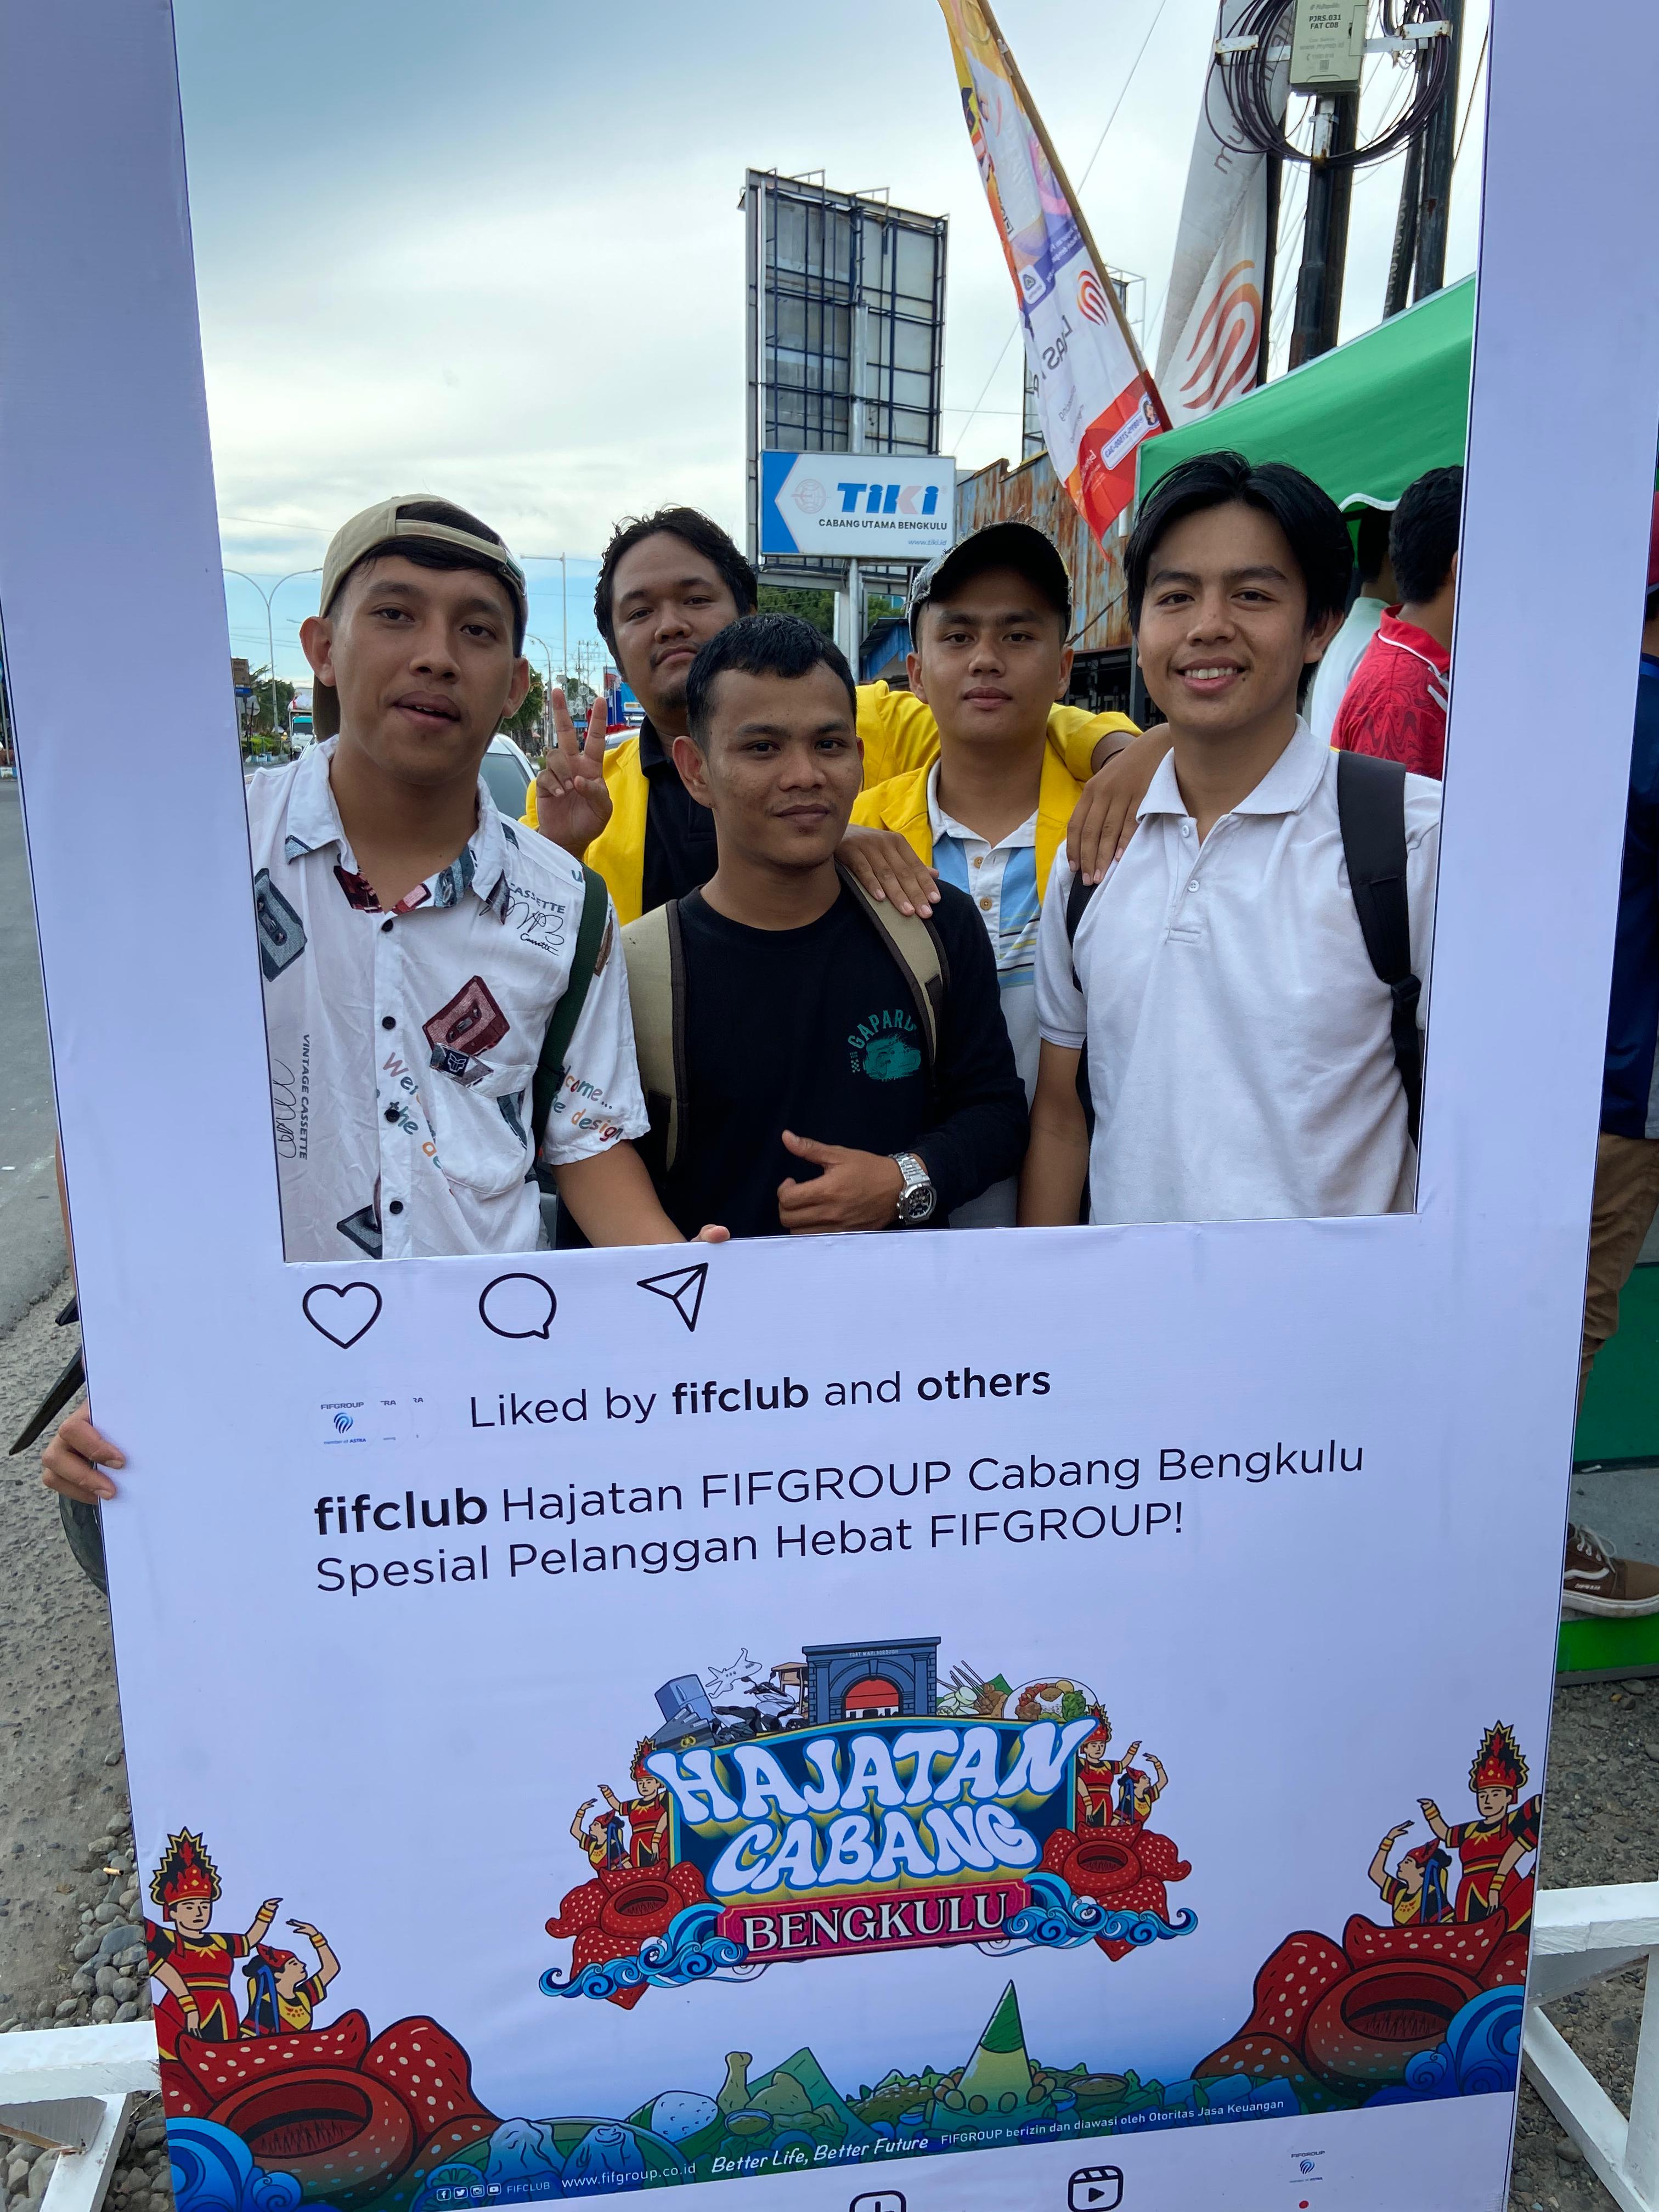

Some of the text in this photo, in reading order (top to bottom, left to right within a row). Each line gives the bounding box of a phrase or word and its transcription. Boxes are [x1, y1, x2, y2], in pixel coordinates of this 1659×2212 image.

[819, 519, 947, 530] CABANG UTAMA BENGKULU
[300, 1096, 309, 1161] CASSETTE
[571, 1108, 624, 1142] design
[320, 1402, 364, 1410] FIFGROUP
[470, 1367, 1051, 1427] Liked by fifclub and others
[314, 1439, 1363, 1536] fifclub Hajatan FIFGROUP Cabang Bengkulu
[317, 1502, 1182, 1597] Spesial Pelanggan Hebat FIFGROUP!
[645, 1718, 1097, 1825] HAJATAN
[708, 1805, 1042, 1895] CABANG
[742, 1892, 1008, 1953] BENGKULU
[941, 2101, 1284, 2145] FIFGROUP berizin dan diawasi oleh Otoritas Jasa Keuangan
[507, 2163, 696, 2194] FIFCLUB www.fifgroup.co.id
[711, 2138, 929, 2173] Better Life, Better Future
